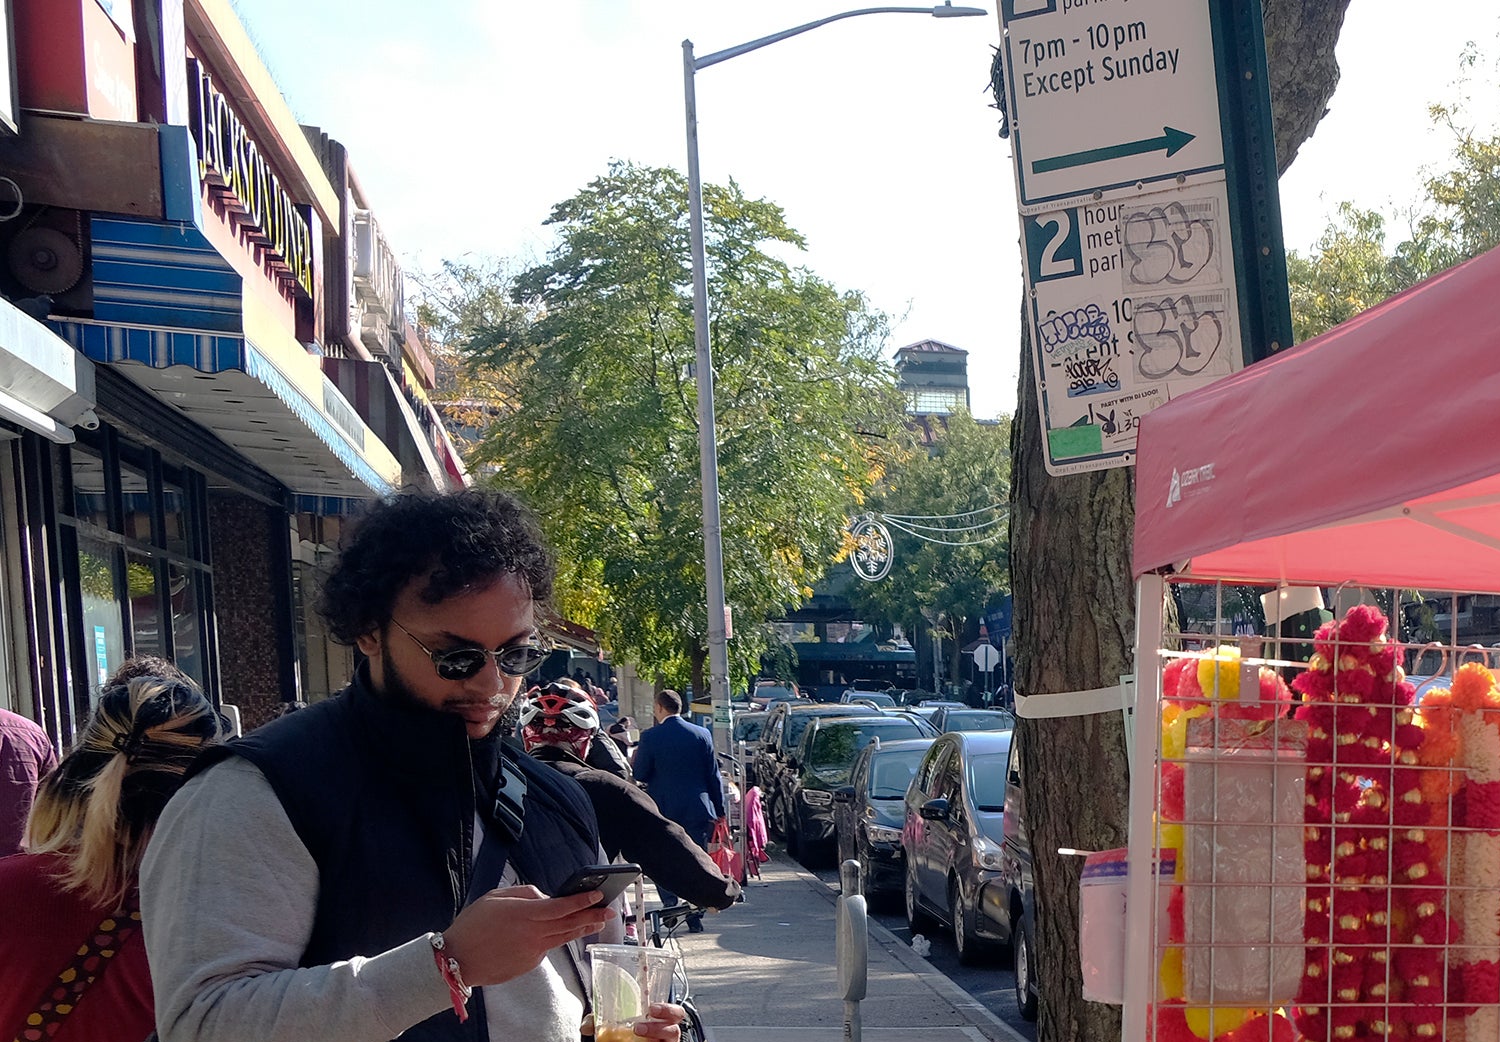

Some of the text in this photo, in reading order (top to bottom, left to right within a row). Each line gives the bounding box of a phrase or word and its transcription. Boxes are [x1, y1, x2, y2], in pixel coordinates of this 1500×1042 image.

[1019, 37, 1066, 67] 7pm
[1023, 47, 1180, 98] Except Sunday
[196, 58, 272, 243] JACKSON
[1084, 204, 1125, 226] hour
[1035, 210, 1075, 277] 2
[1100, 399, 1118, 409] PARTY
